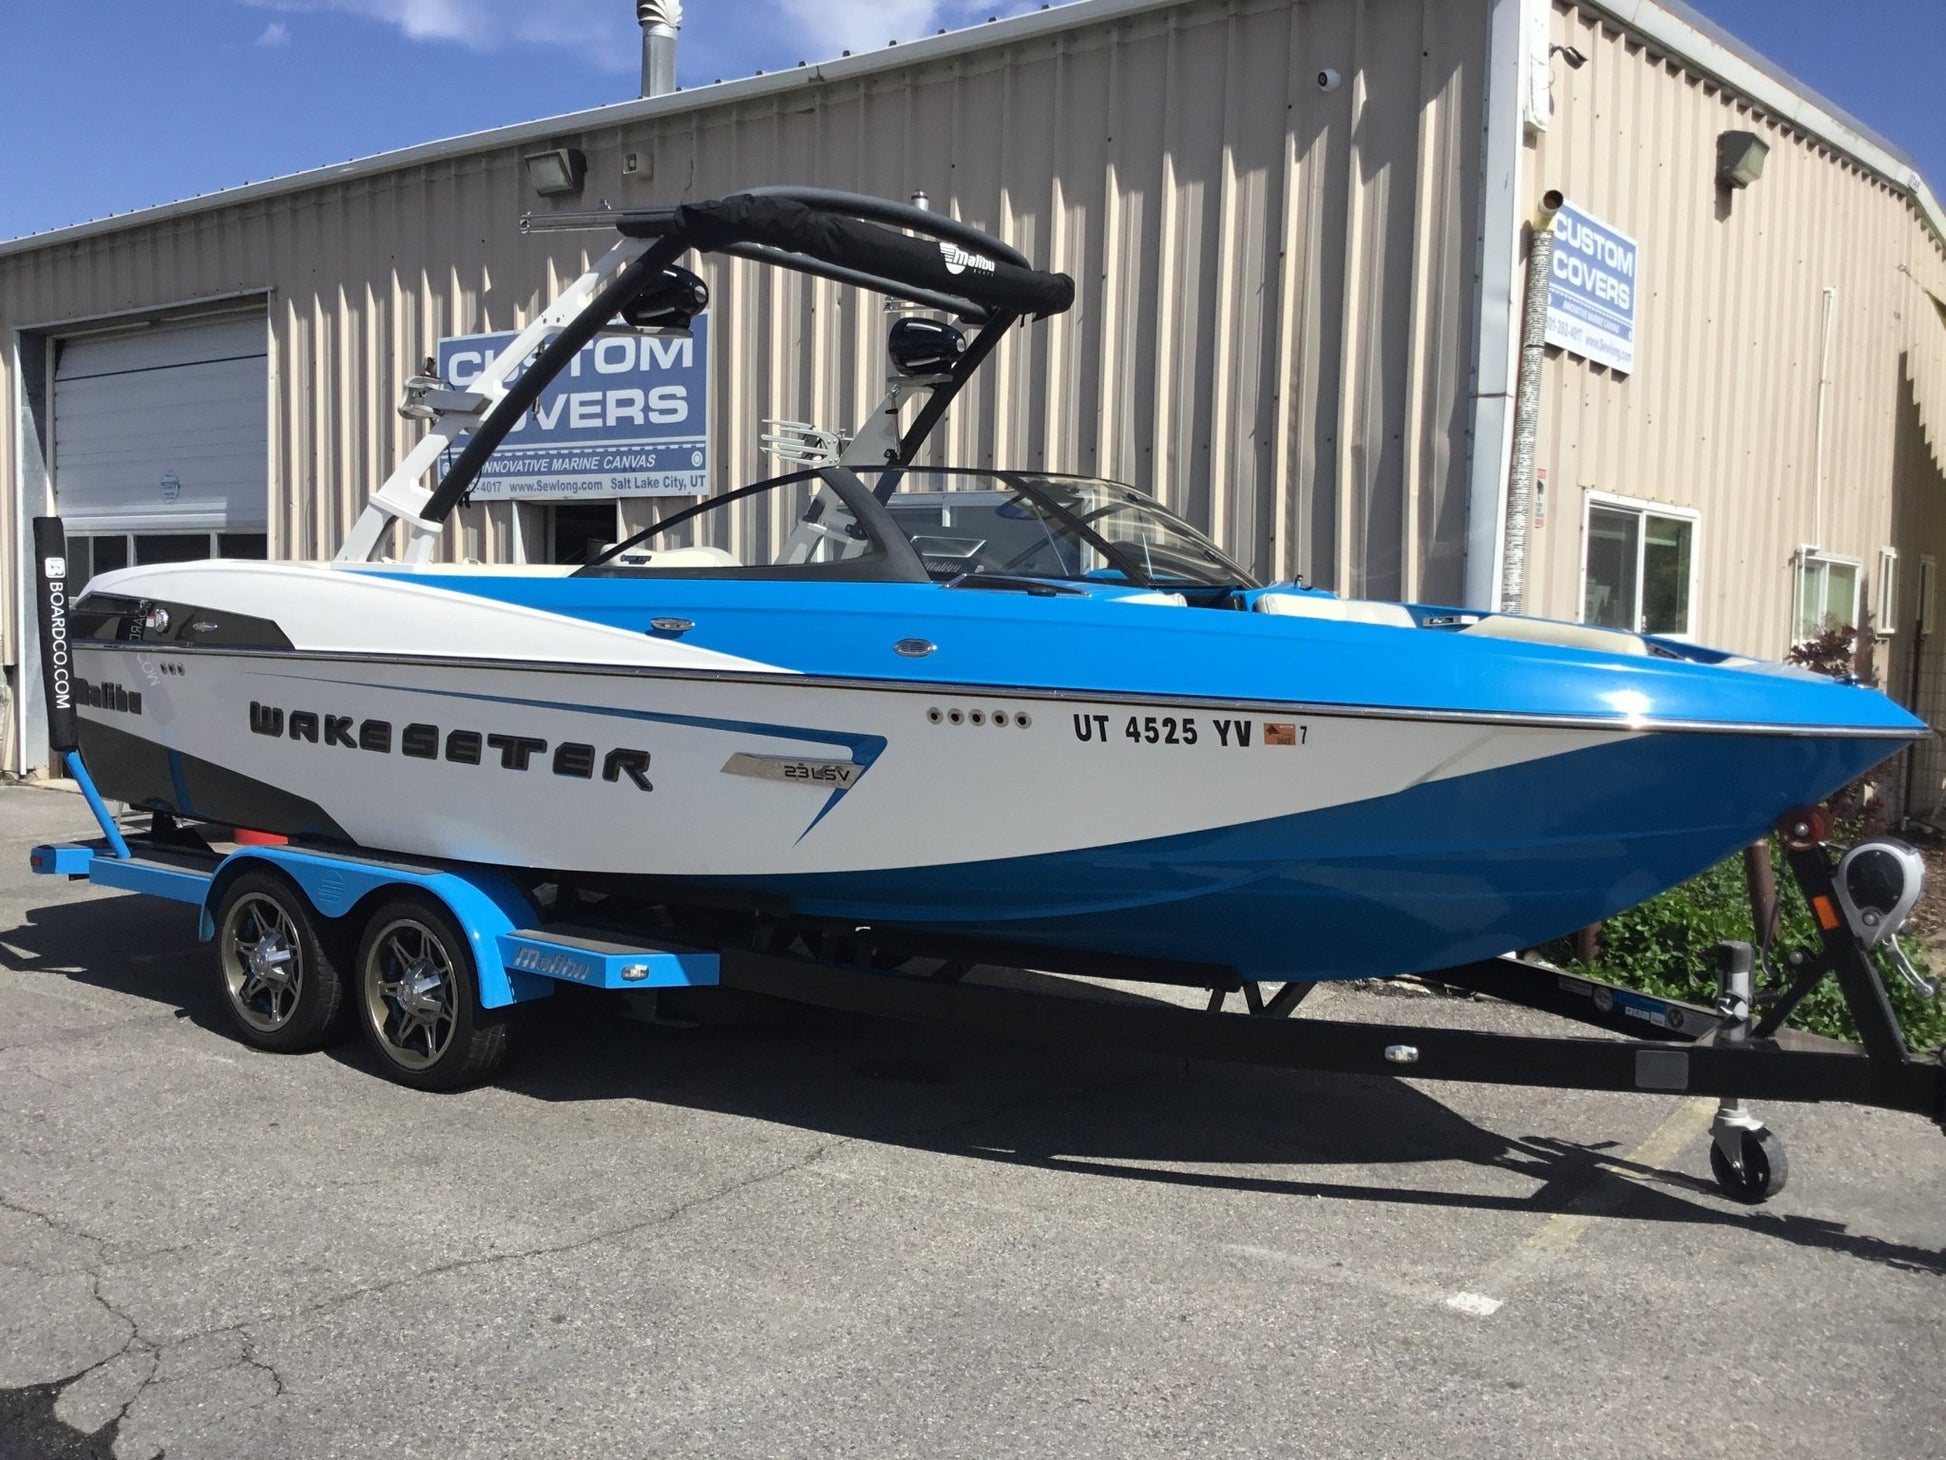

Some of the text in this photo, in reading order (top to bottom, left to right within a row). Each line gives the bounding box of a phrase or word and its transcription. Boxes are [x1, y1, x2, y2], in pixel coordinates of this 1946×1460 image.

[1553, 211, 1634, 278] CUSTOM
[1552, 249, 1631, 311] COVERS
[448, 337, 693, 387] CTOM
[458, 385, 689, 435] VERS
[509, 479, 603, 495] www.Sewlong.com
[610, 477, 632, 490] Salt
[634, 476, 660, 490] Lake
[663, 475, 687, 491] City,
[690, 475, 706, 488] UT
[551, 456, 600, 471] MARINE
[603, 454, 657, 469] CANVAS
[49, 582, 71, 709] BOARDCO.COM
[249, 700, 654, 792] WAKESETTER
[1073, 713, 1251, 747] UT 4525 YV
[1300, 725, 1308, 745] 7
[783, 765, 851, 782] 23LSV
